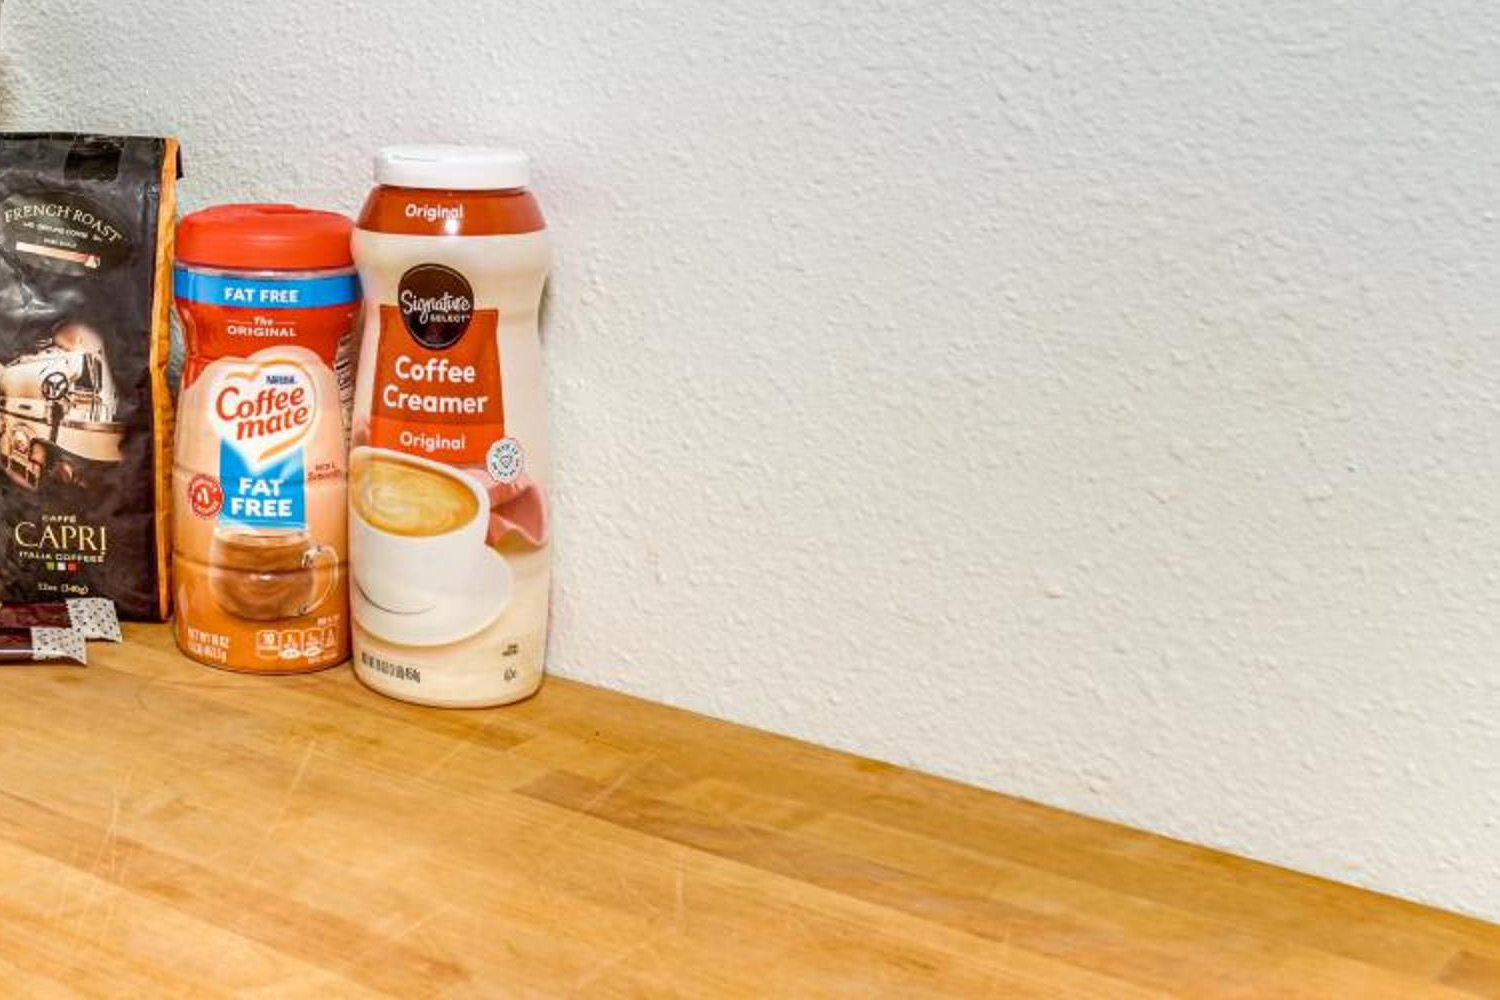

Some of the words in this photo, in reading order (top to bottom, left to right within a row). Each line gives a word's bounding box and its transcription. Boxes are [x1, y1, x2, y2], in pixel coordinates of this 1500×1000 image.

[4, 204, 71, 223] FRENCH
[72, 209, 123, 242] ROAST
[404, 203, 464, 222] Original
[224, 287, 256, 301] FAT
[260, 289, 300, 303] FREE
[401, 289, 471, 325] Signature
[227, 326, 297, 337] ORIGINAL
[254, 316, 274, 327] The
[395, 356, 476, 383] Coffee
[215, 386, 305, 422] Coffee
[383, 384, 489, 413] Creamer
[237, 406, 309, 441] mate
[399, 431, 466, 453] Original
[239, 477, 285, 497] FAT
[231, 497, 293, 518] FREE
[14, 521, 107, 551] CAPRI
